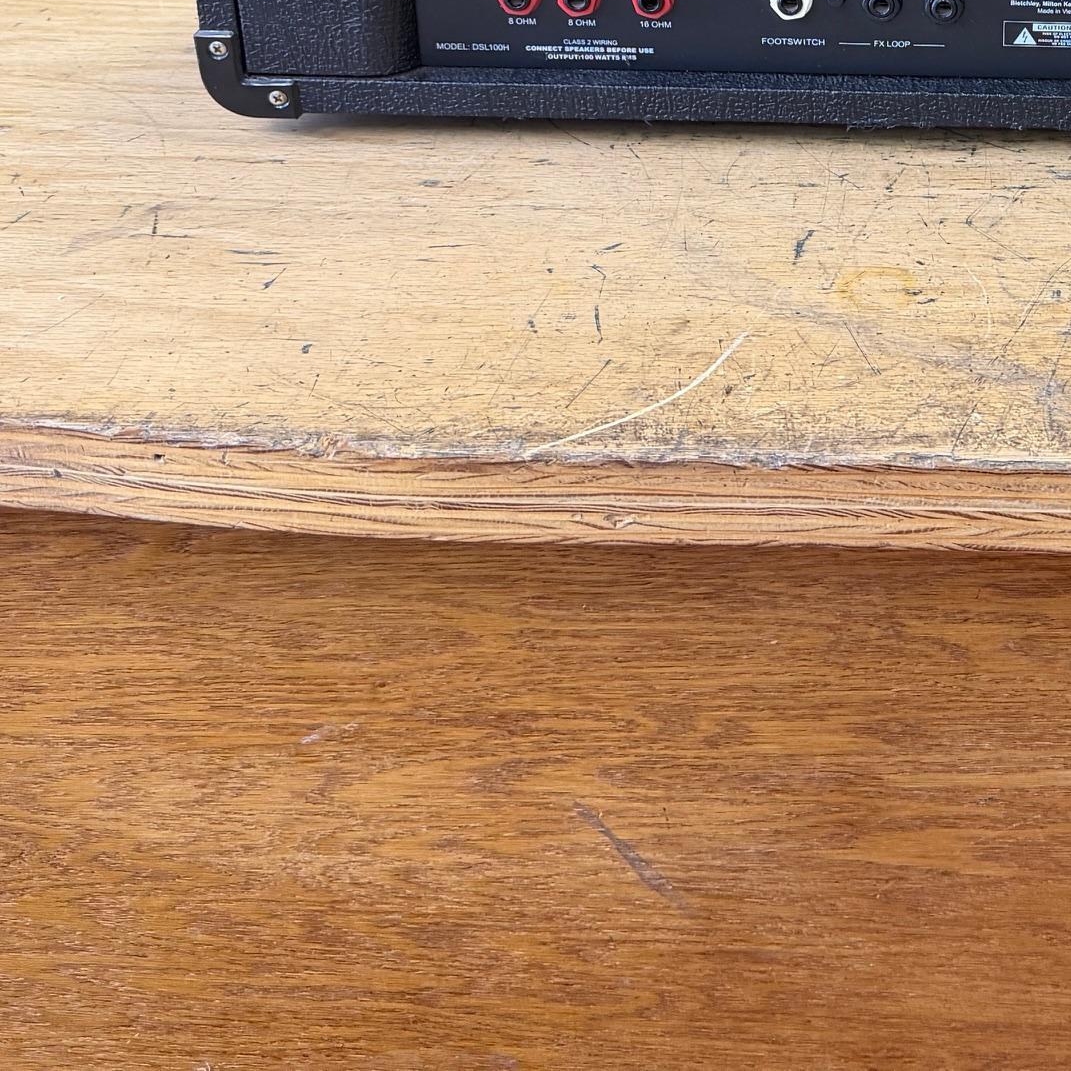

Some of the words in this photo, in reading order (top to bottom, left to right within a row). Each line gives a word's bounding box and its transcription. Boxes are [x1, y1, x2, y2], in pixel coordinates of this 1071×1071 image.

[508, 17, 514, 25] 8
[515, 17, 537, 26] OHM
[567, 18, 574, 26] 8
[575, 19, 597, 27] OHM
[640, 20, 650, 28] 16
[651, 21, 672, 29] OHM
[563, 38, 586, 46] CLASS
[761, 37, 826, 46] FOOTSWITCH
[436, 42, 471, 51] MODEL:
[472, 43, 510, 52] DSL100H
[564, 45, 605, 53] SPEAKERS
[606, 46, 637, 54] BEFORE
